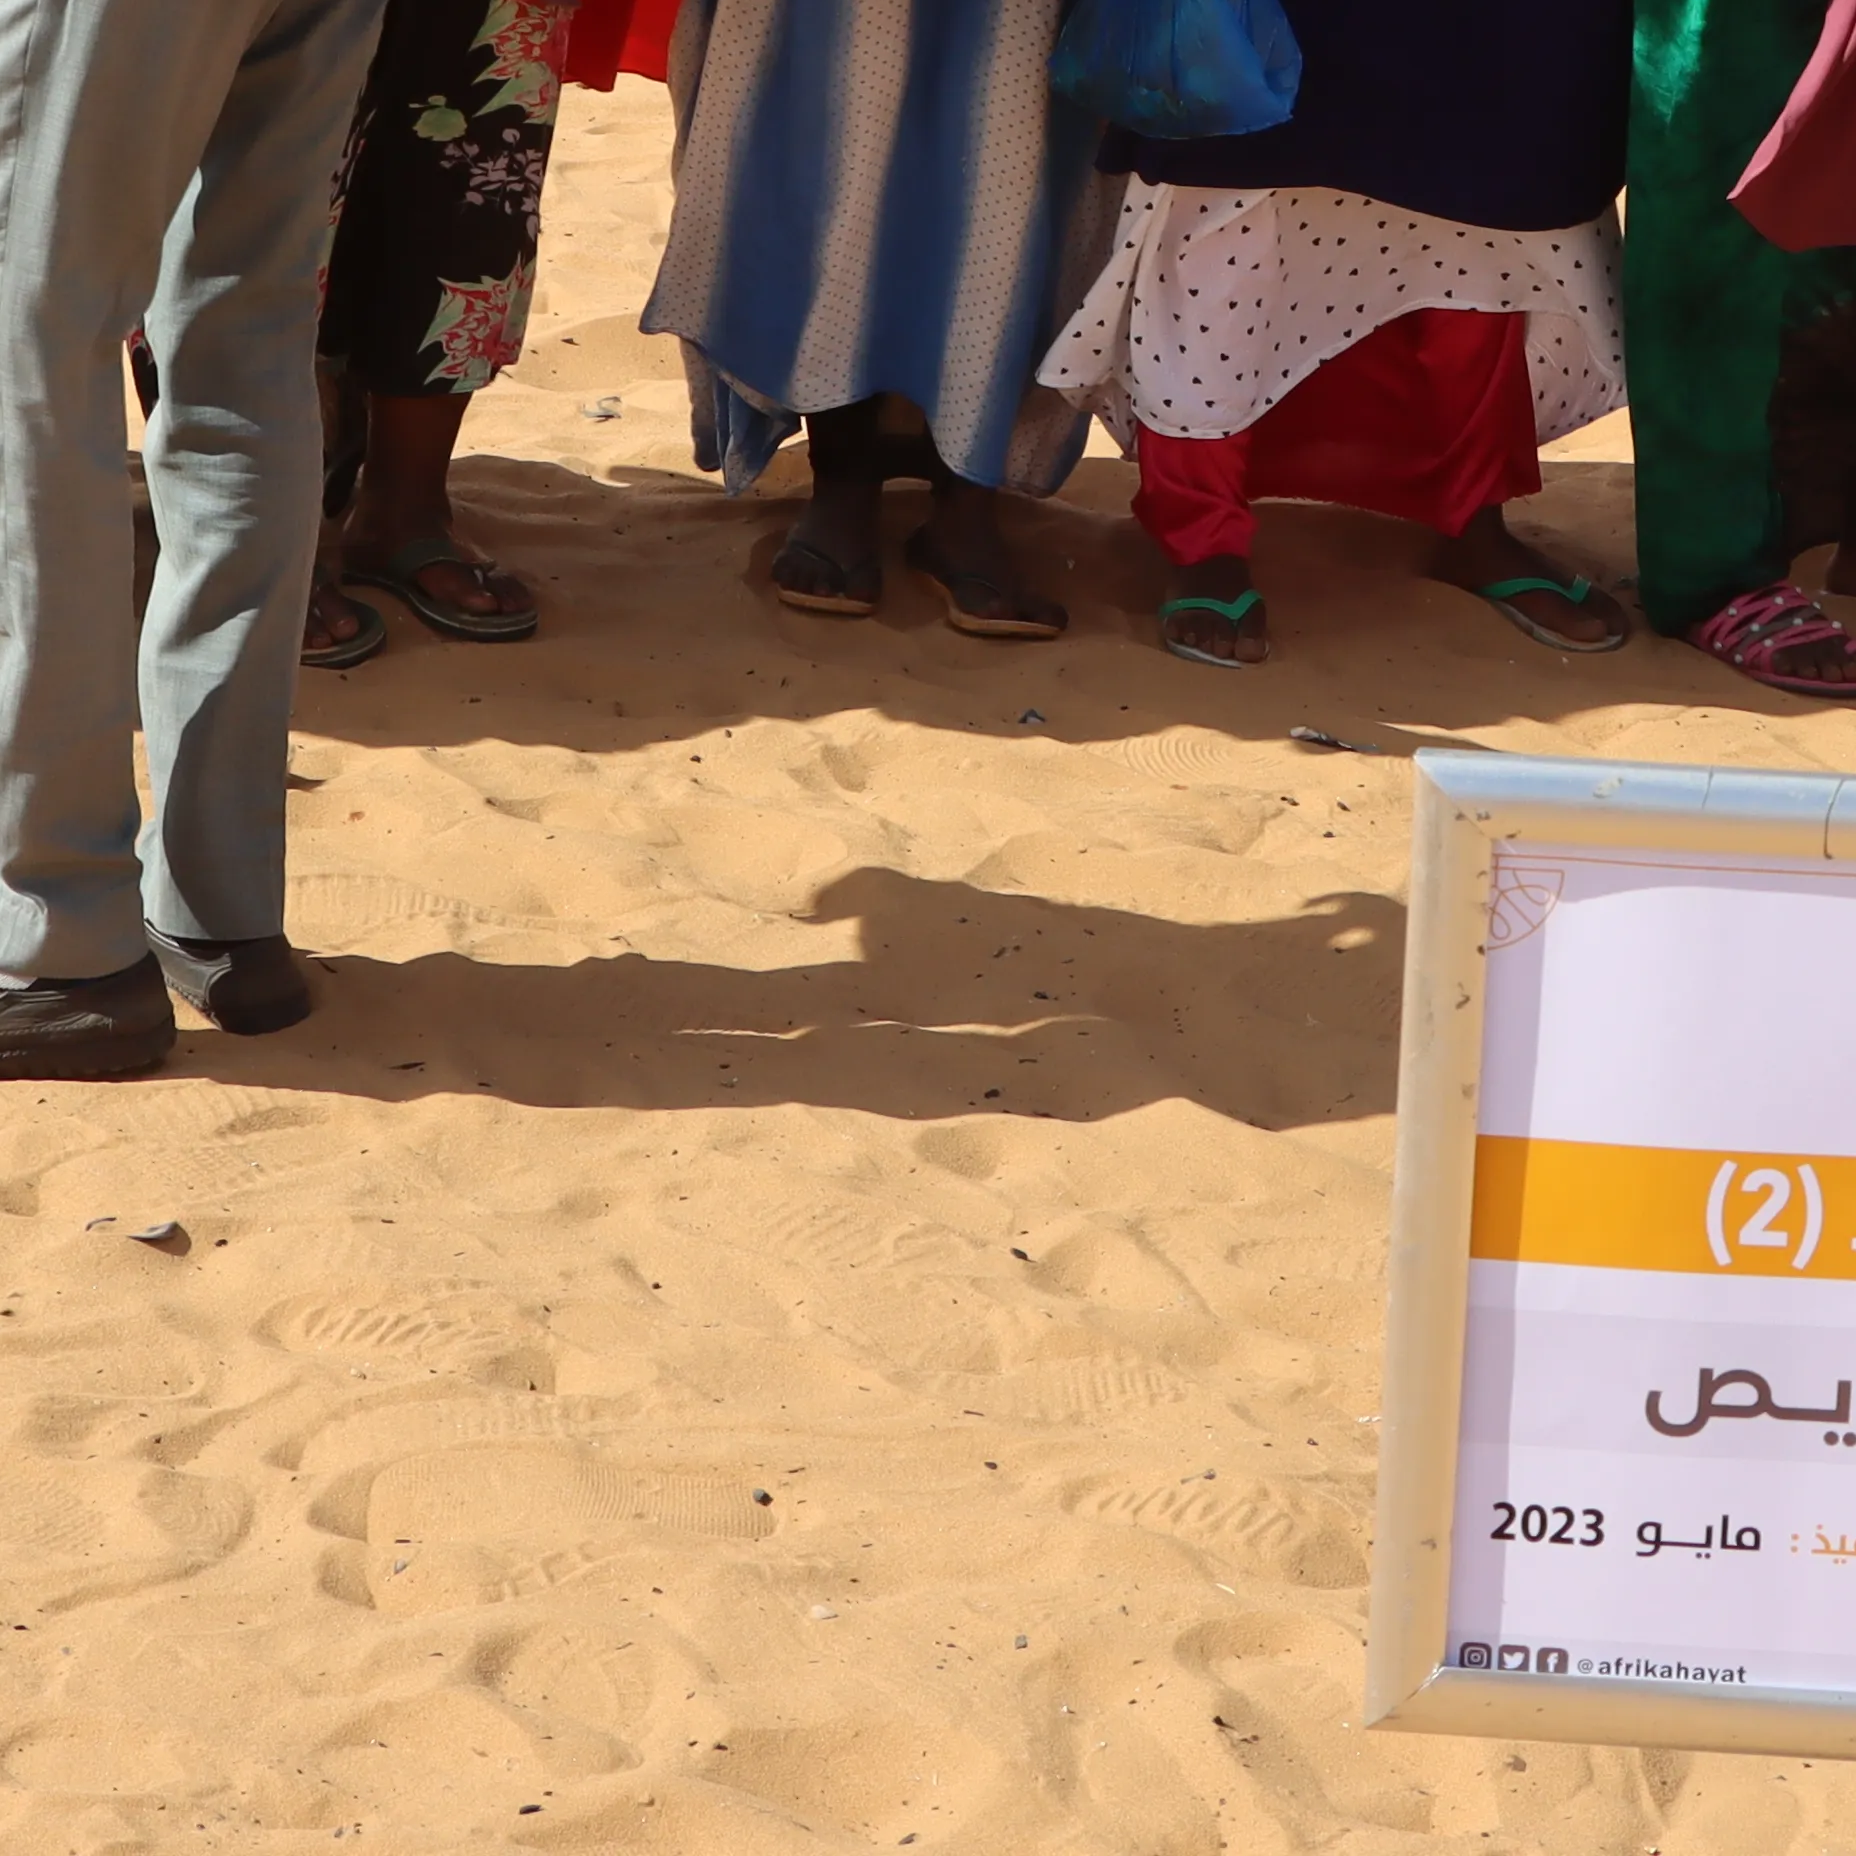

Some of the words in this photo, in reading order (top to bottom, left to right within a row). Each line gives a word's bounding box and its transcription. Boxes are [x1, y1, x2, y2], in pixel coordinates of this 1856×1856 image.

[1705, 1159, 1824, 1271] (2)
[1490, 1501, 1605, 1547] 2023
[1635, 1514, 1761, 1559] مايو
